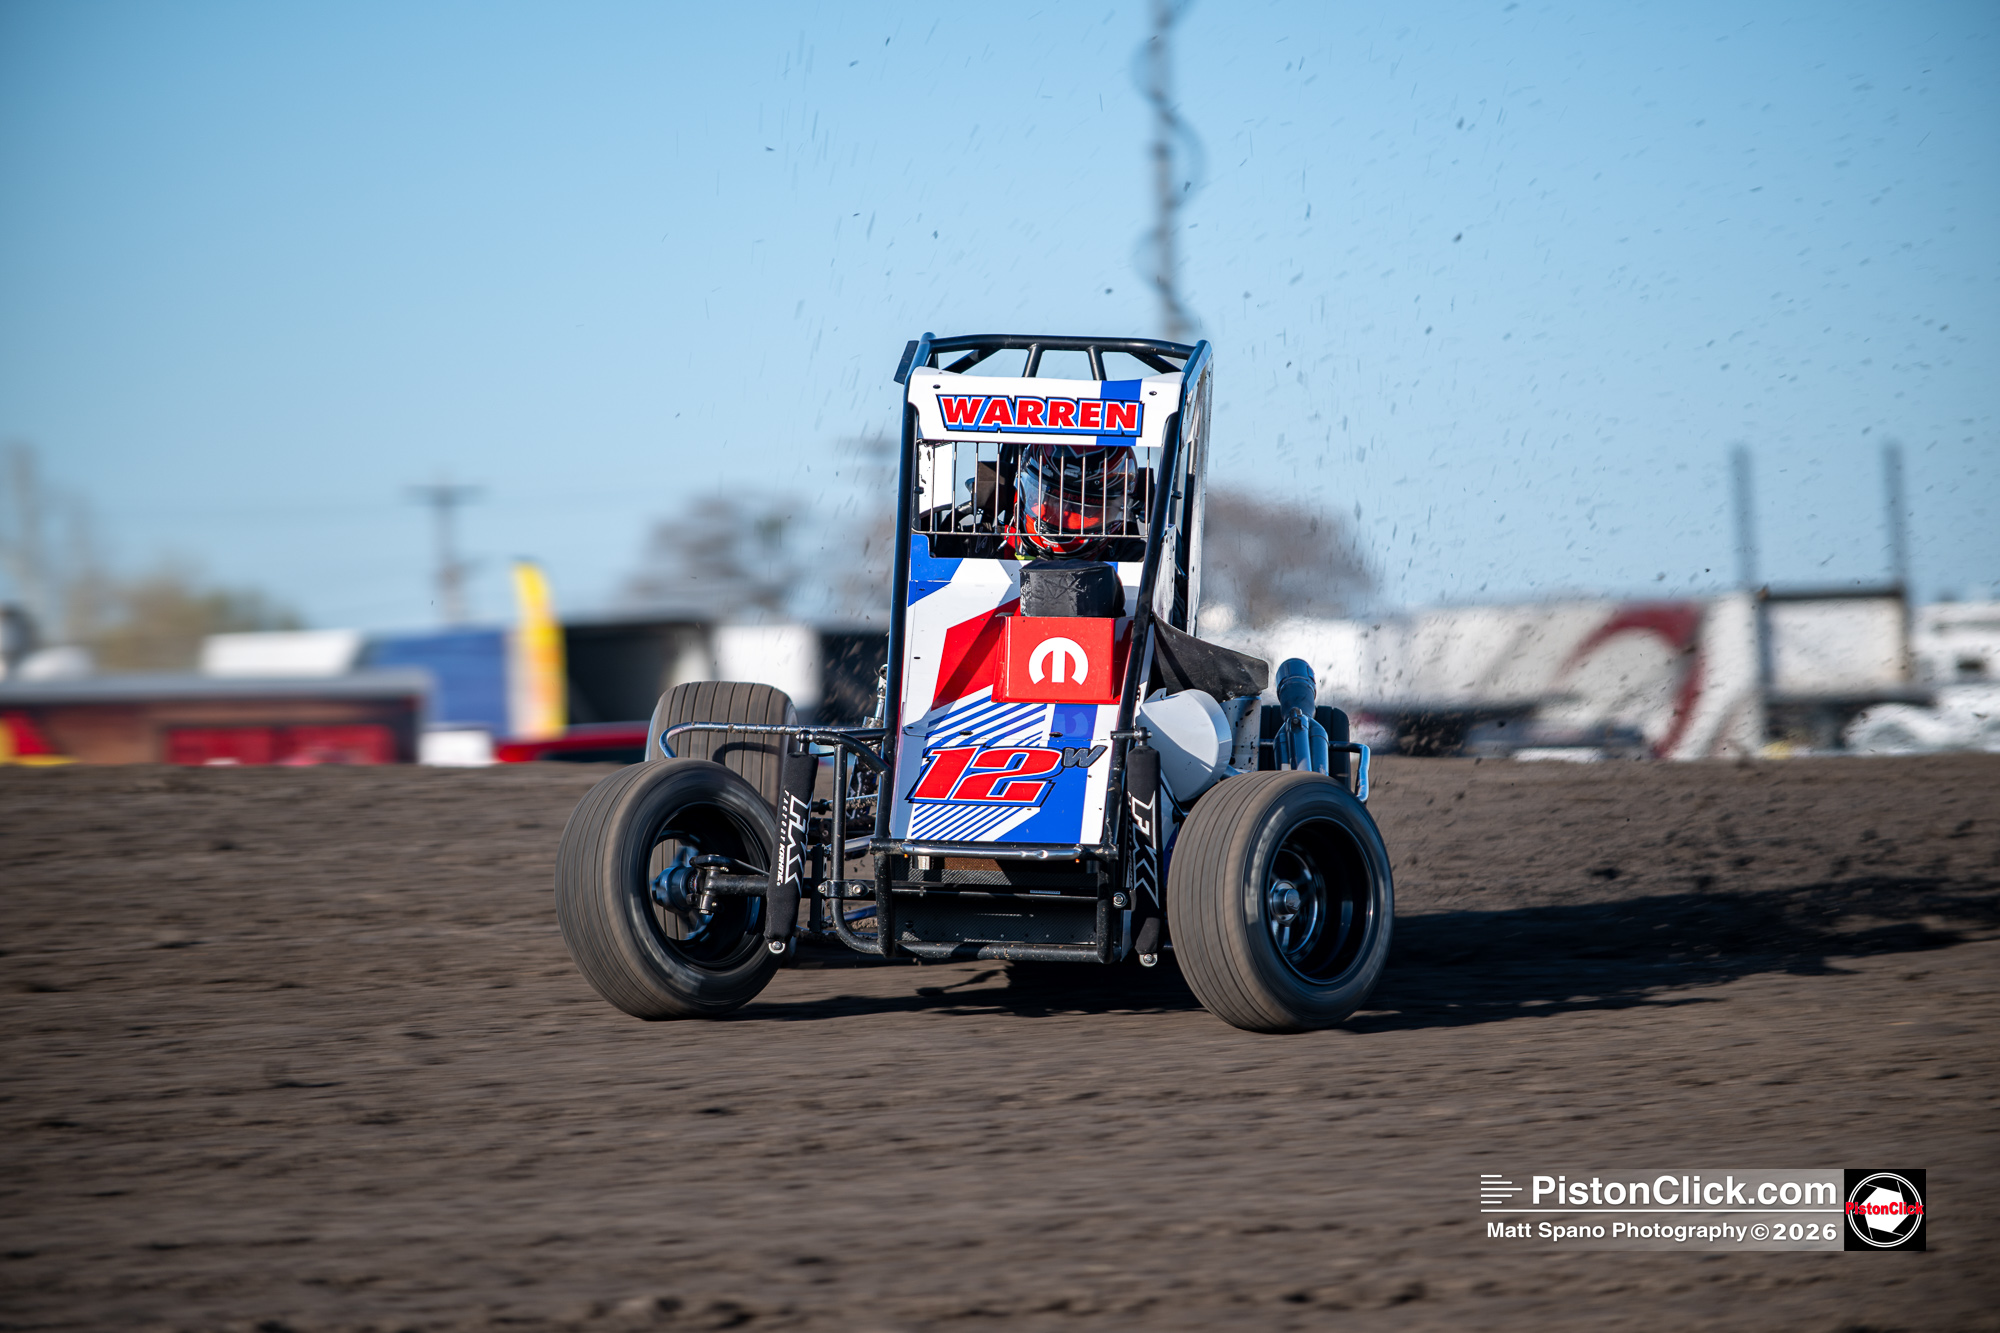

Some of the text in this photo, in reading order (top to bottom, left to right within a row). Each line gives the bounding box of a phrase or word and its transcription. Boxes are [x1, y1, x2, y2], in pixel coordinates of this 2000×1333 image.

[937, 395, 1143, 436] WARREN
[776, 788, 790, 885] FACTORY KAHNE
